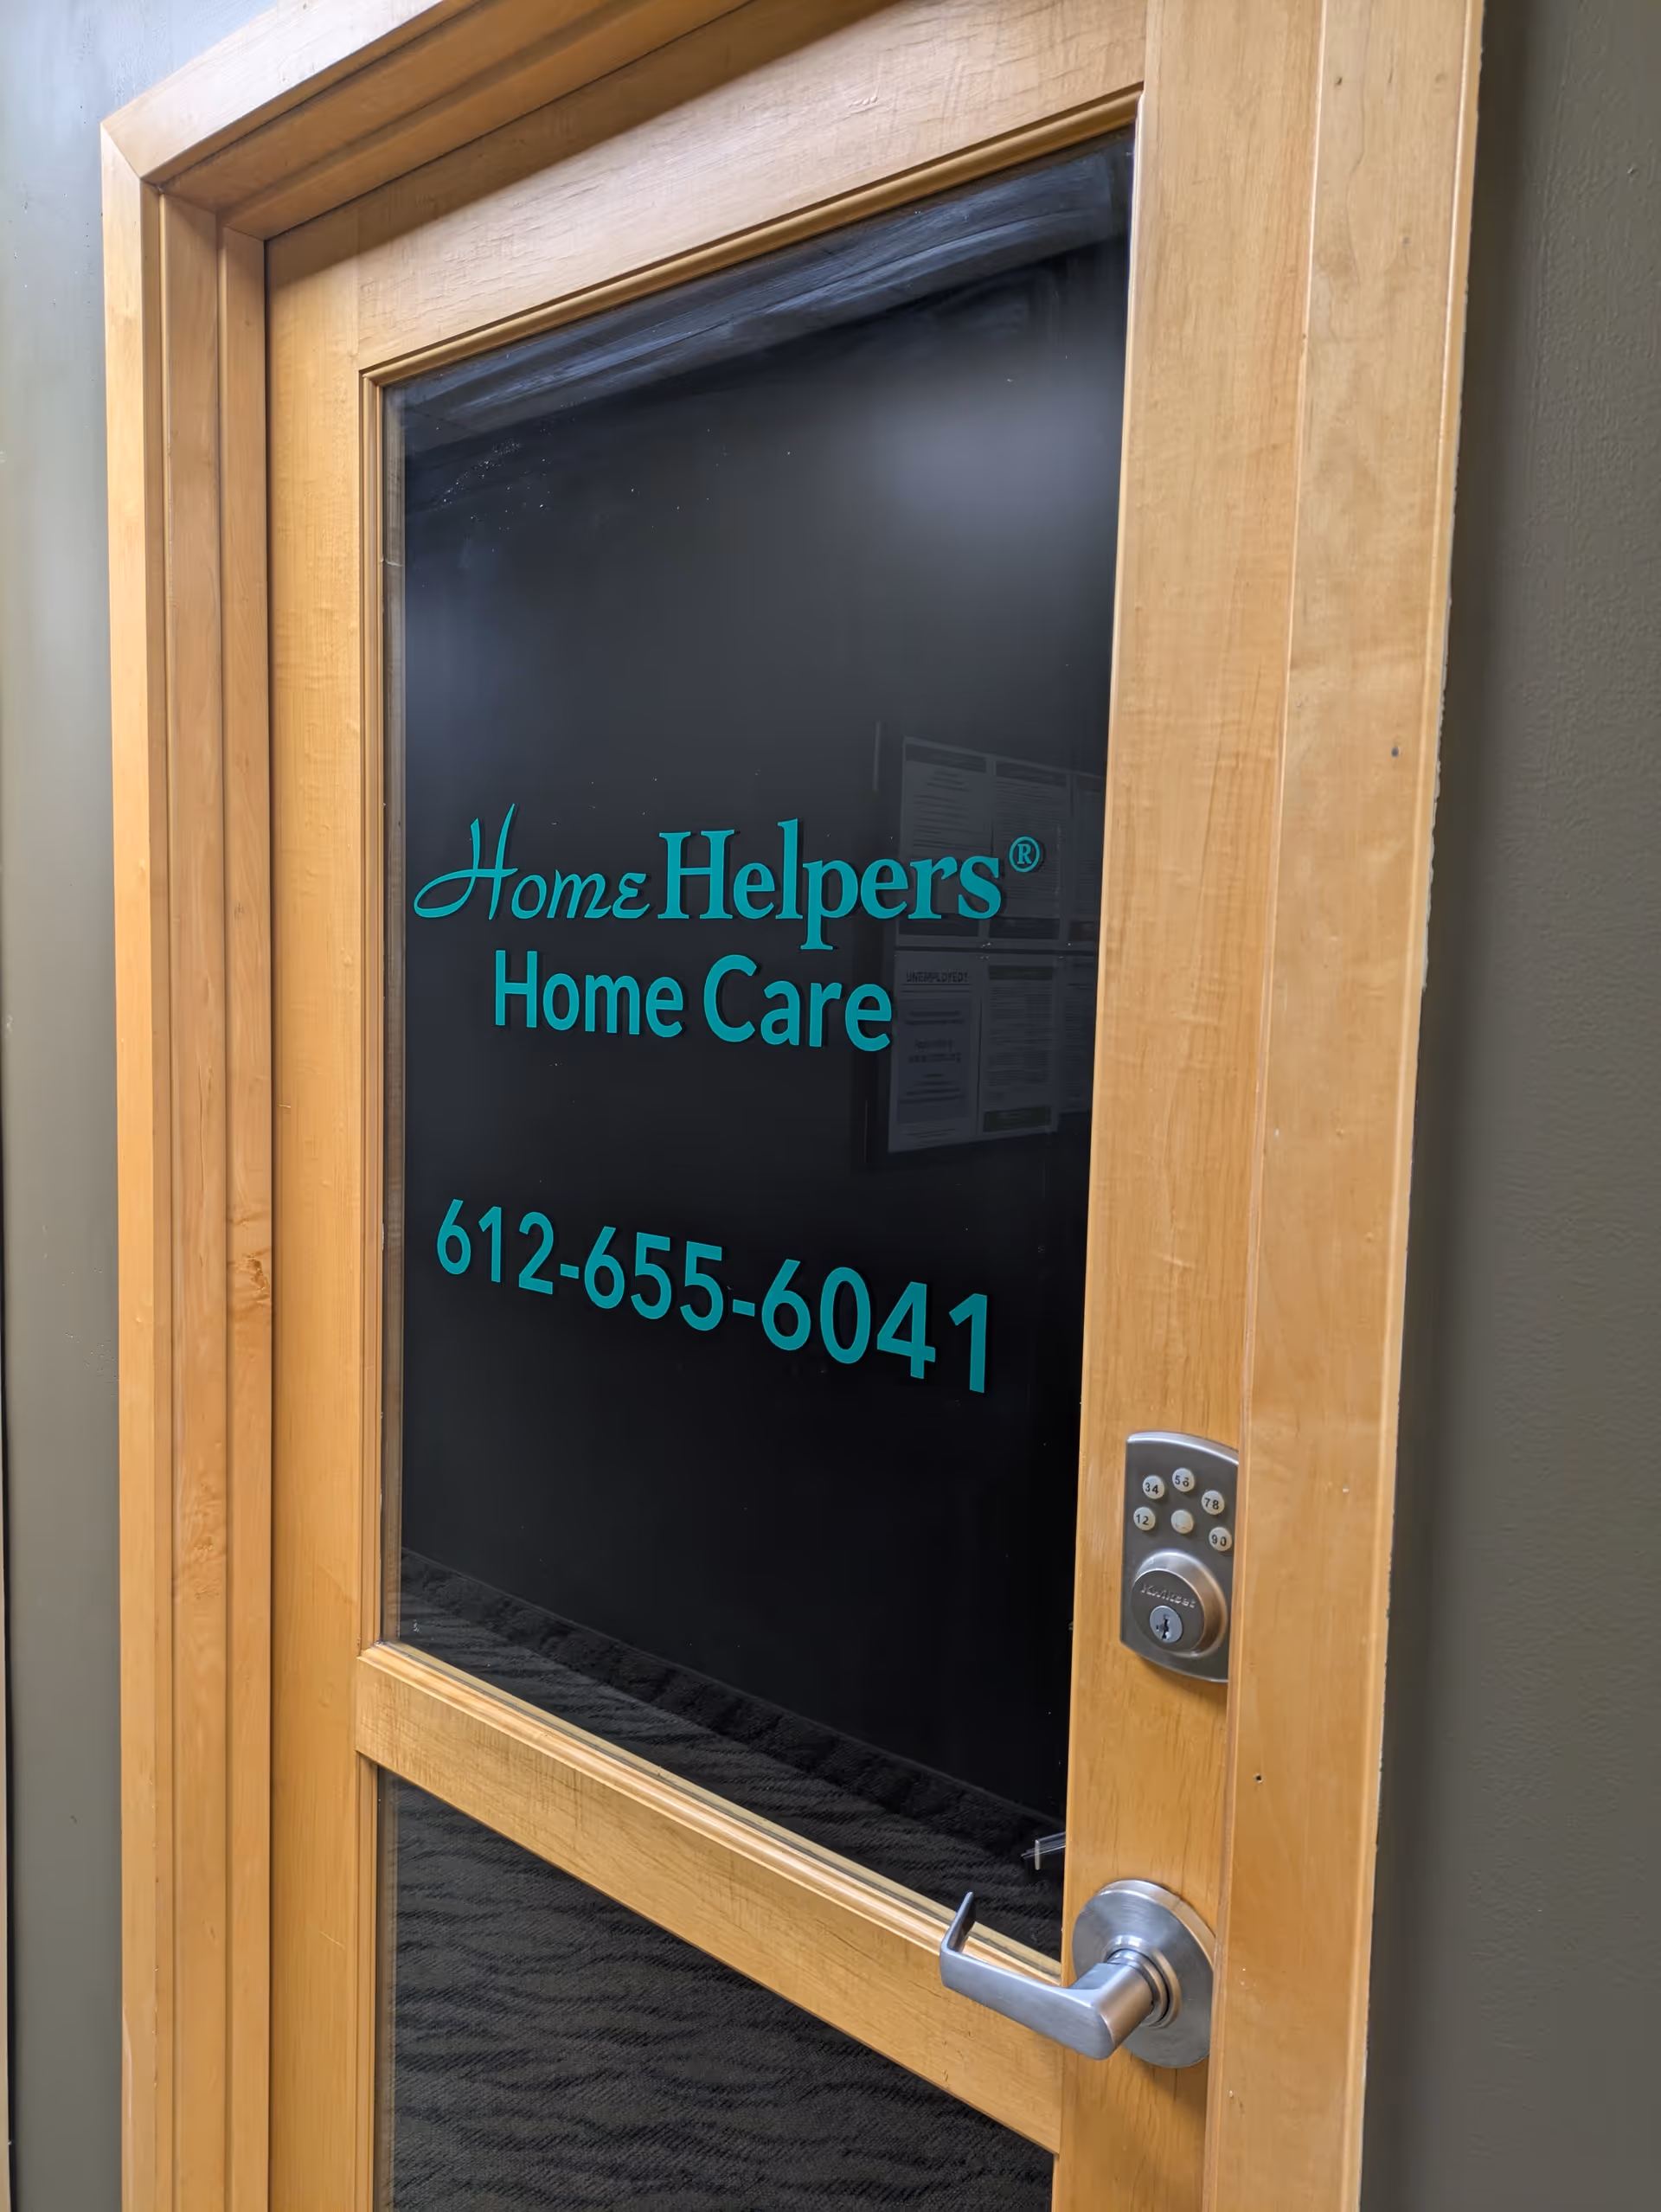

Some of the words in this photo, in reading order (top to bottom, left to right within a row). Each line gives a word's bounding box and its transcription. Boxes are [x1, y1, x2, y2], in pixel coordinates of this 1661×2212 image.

[413, 803, 651, 921] Home
[494, 949, 684, 1038] Home
[702, 953, 893, 1052] Care
[436, 1198, 989, 1394] 612-655-6041
